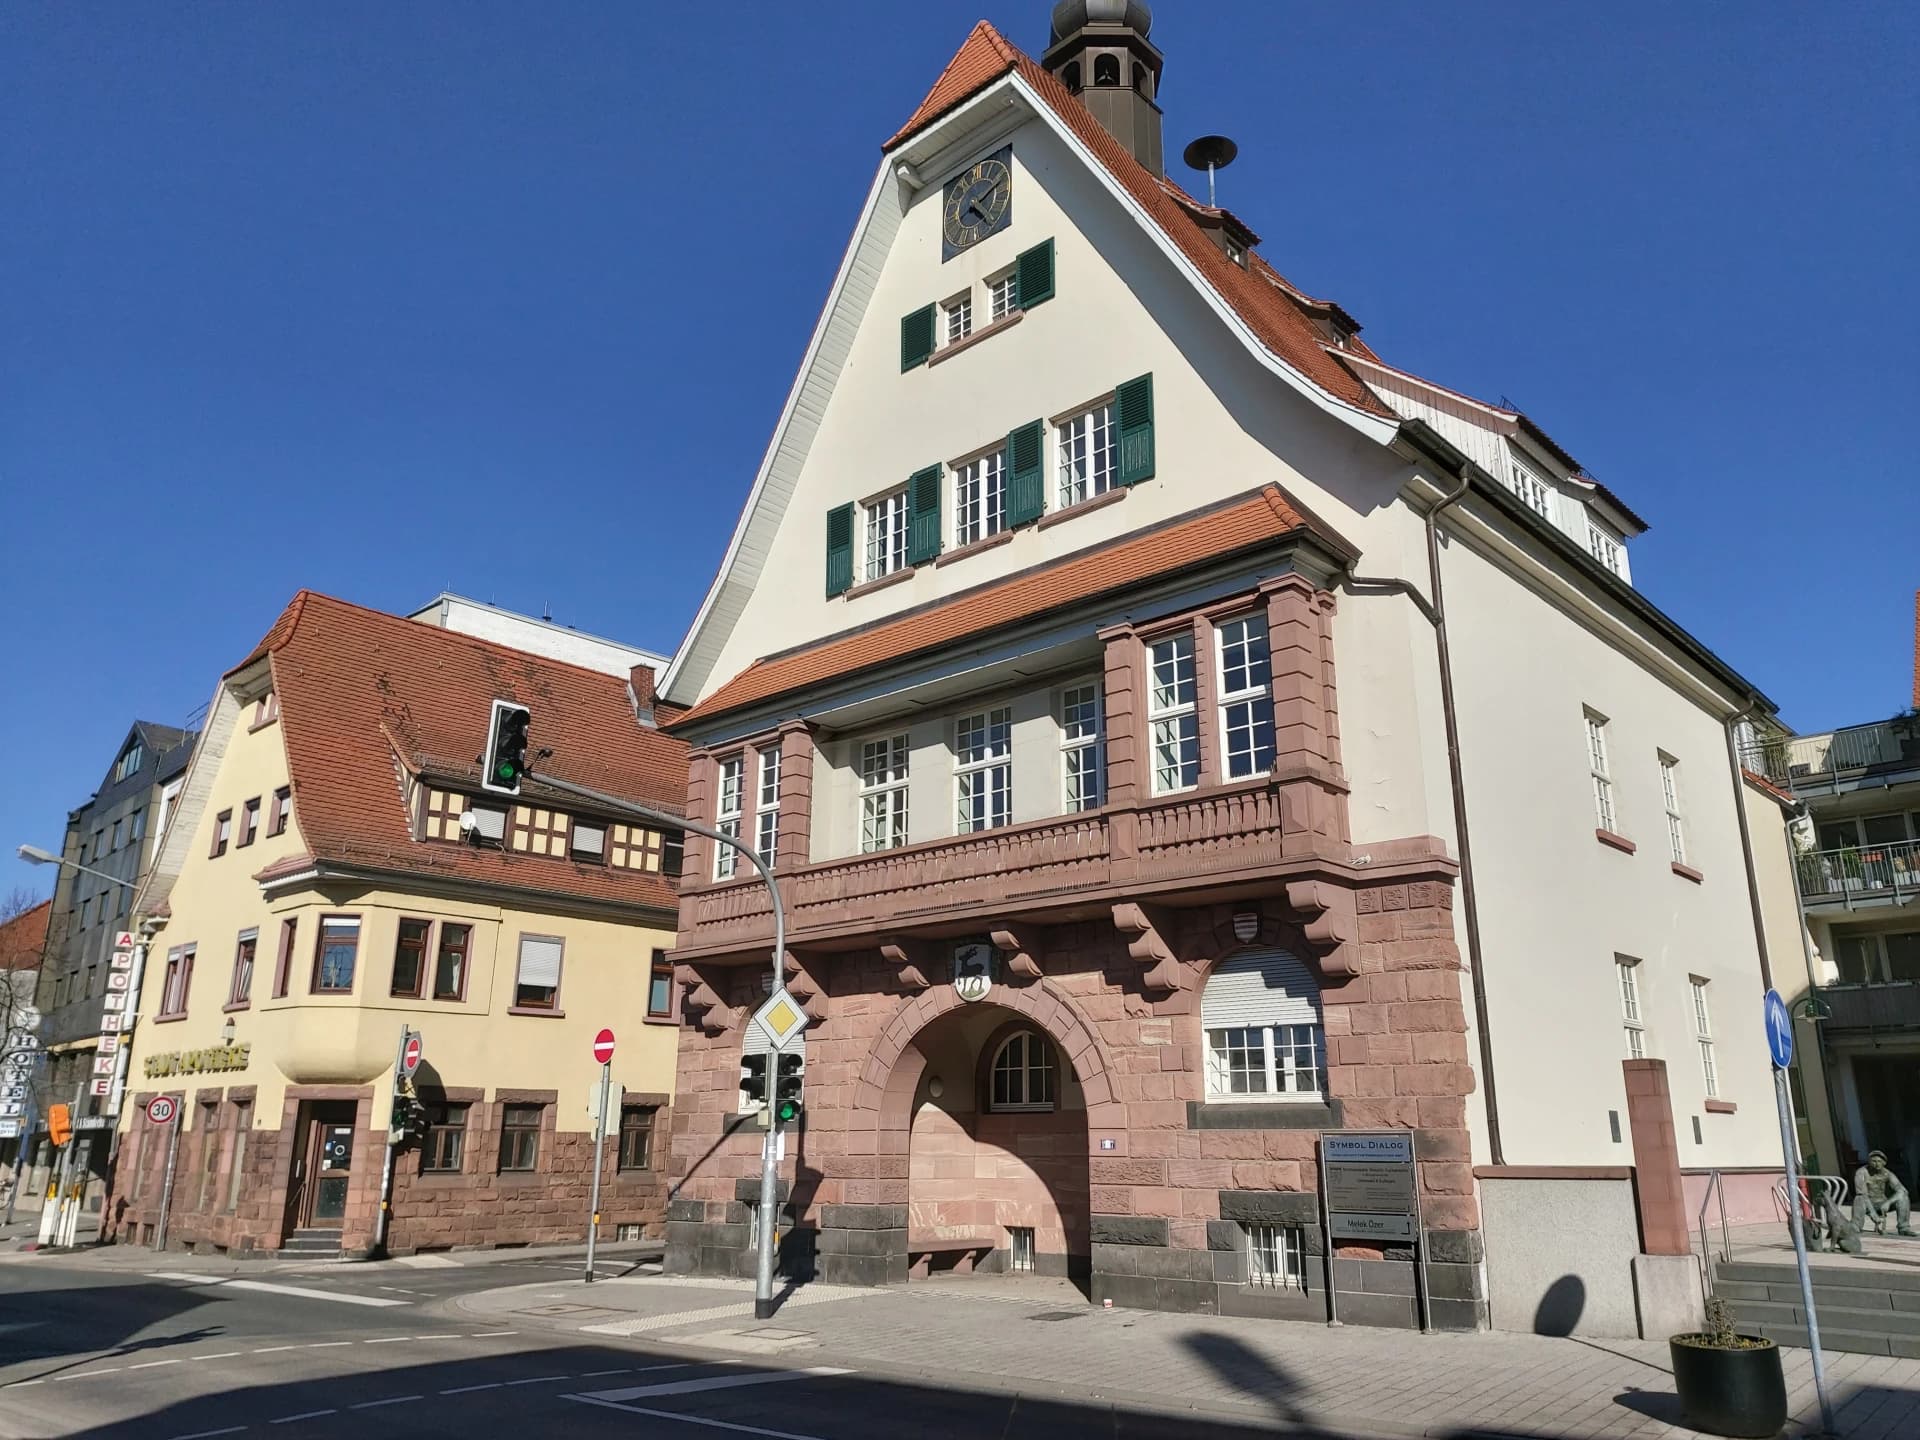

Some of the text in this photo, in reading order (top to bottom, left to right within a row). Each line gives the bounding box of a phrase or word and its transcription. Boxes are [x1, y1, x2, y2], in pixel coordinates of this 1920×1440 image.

[96, 933, 133, 1094] APOTHEKE
[5, 1036, 32, 1115] HOTEL
[152, 1103, 170, 1117] 30
